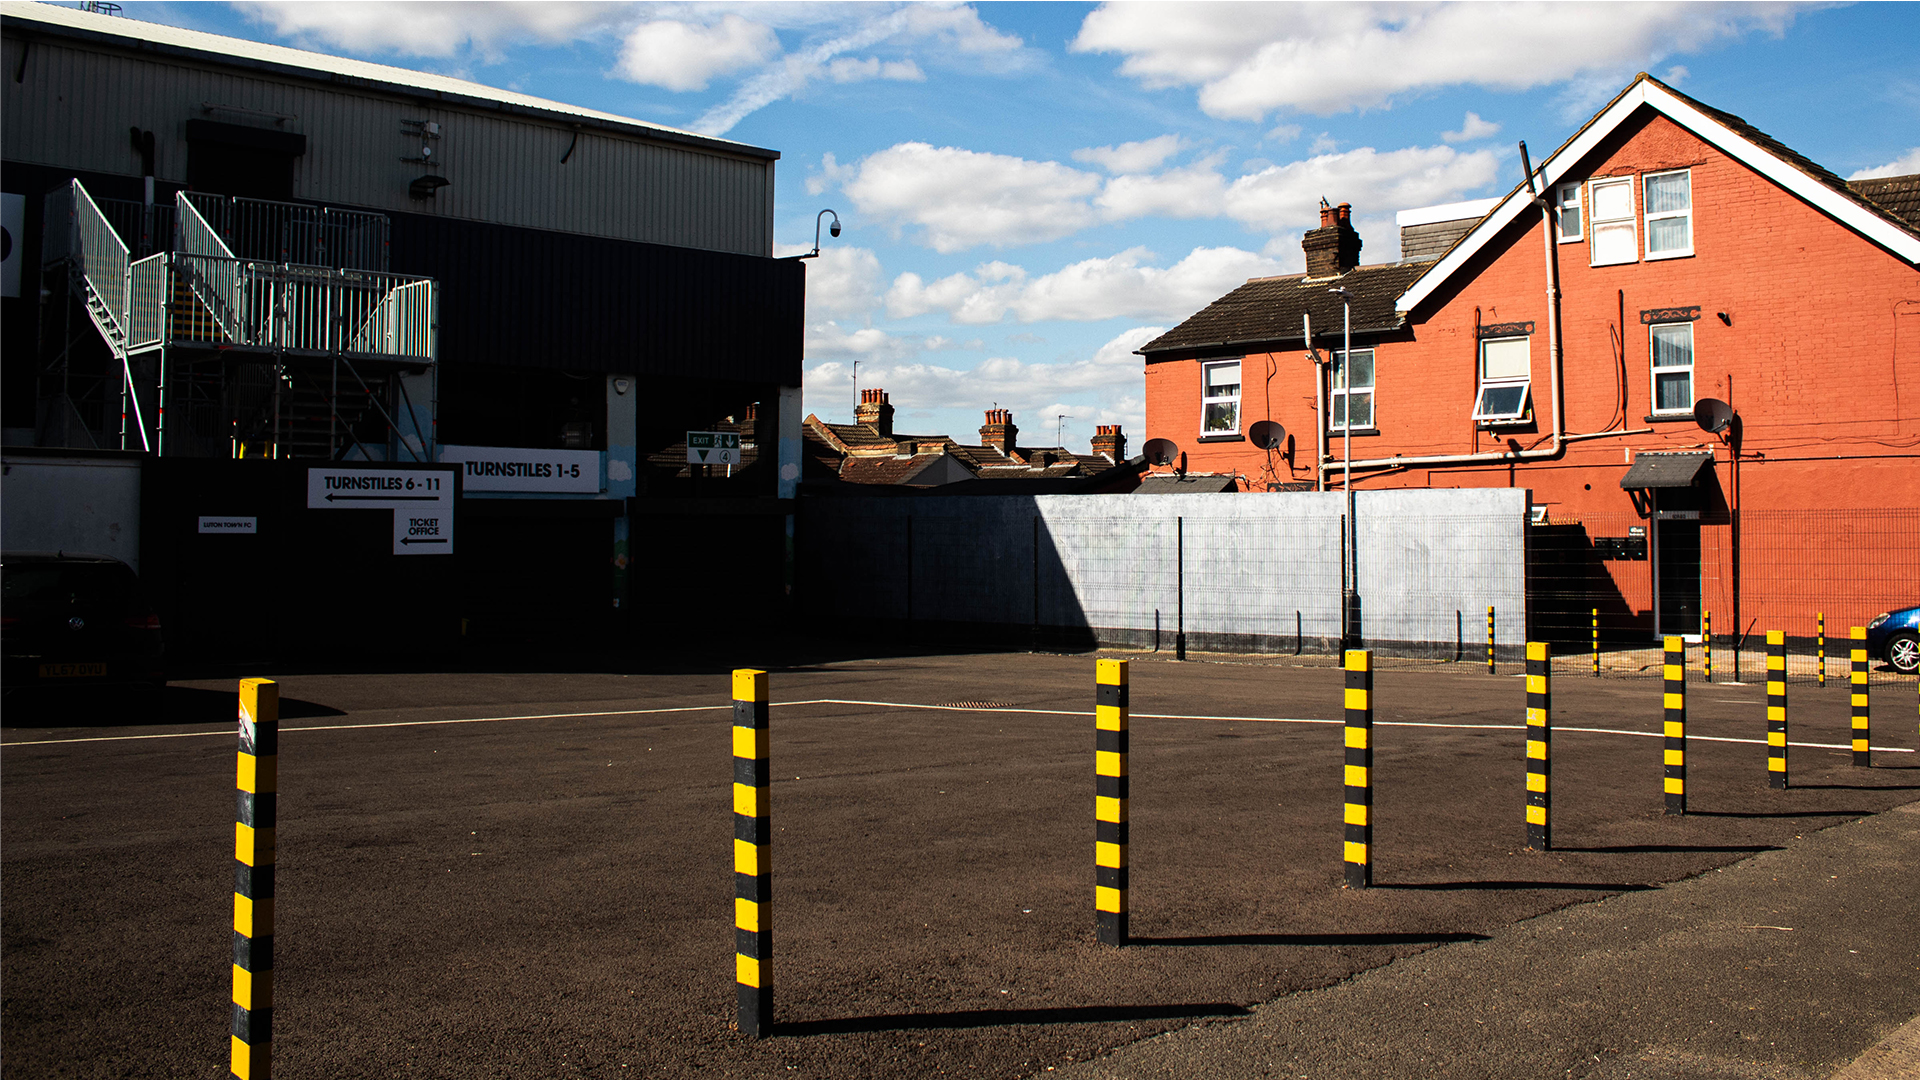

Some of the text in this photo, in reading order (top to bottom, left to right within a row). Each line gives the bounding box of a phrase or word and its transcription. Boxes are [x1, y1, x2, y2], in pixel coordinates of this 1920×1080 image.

[692, 436, 710, 445] EXIT
[465, 461, 581, 479] TURNSTILES 1-5
[324, 476, 403, 490] TURNSTILES
[405, 478, 415, 490] 6
[425, 478, 440, 491] 11
[408, 518, 439, 527] TICKET
[408, 527, 439, 536] OFFICE
[45, 664, 75, 676] YL67
